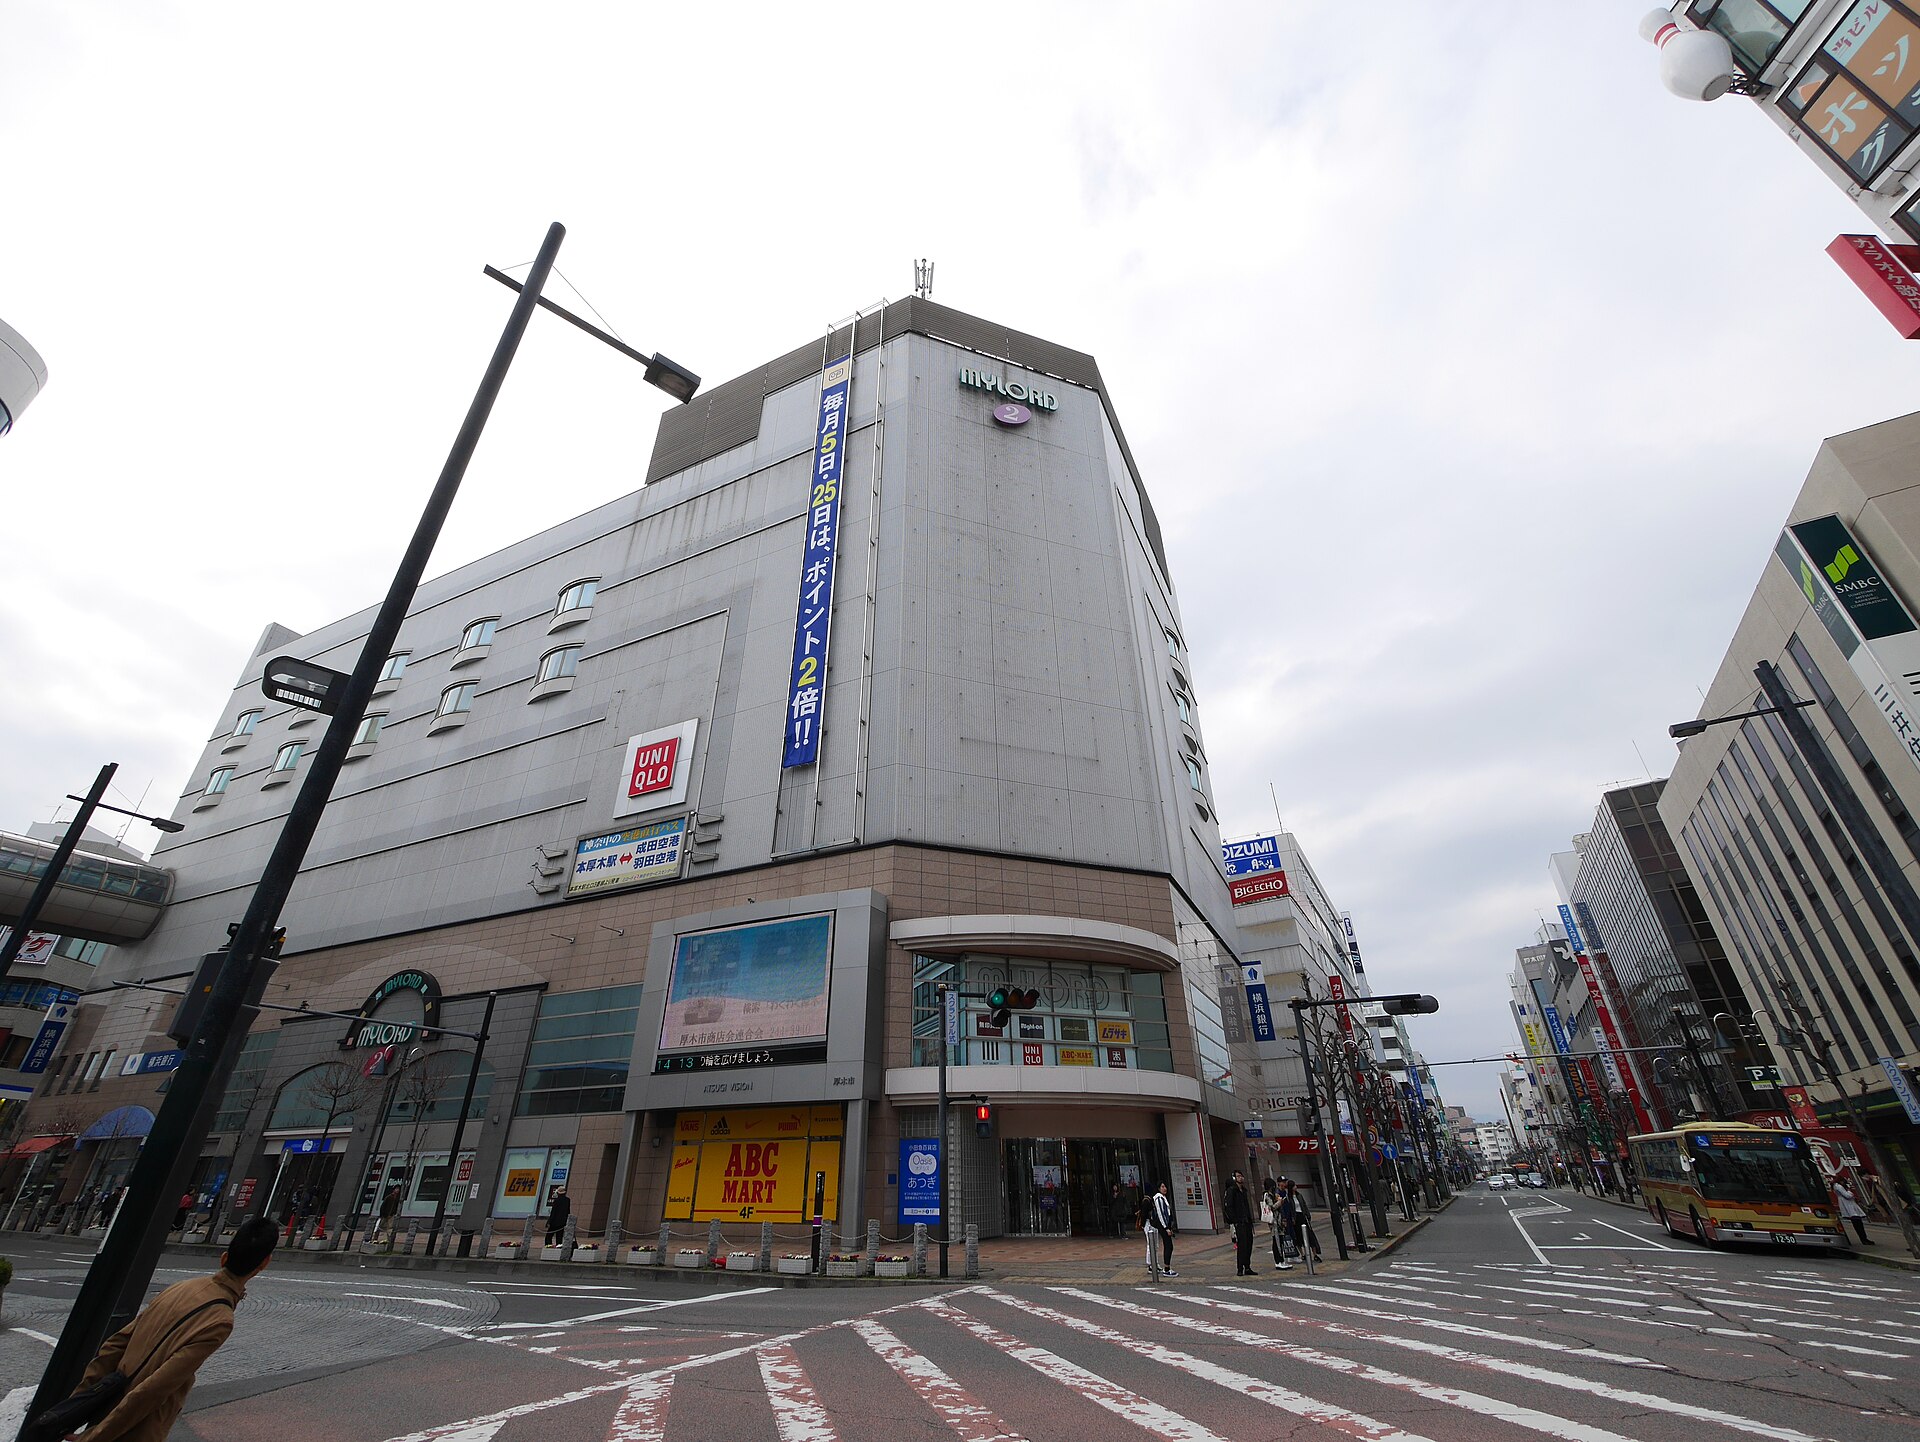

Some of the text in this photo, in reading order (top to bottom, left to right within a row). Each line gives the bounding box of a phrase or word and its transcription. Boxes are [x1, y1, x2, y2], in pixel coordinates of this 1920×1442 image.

[960, 367, 1060, 411] MYLORD
[1003, 405, 1020, 422] 2
[1834, 576, 1880, 594] SMBC
[638, 745, 670, 768] UNI
[634, 765, 669, 791] QLO
[635, 834, 680, 855] 成田空港
[575, 854, 618, 874] 本厚木駅
[632, 849, 678, 870] 羽田空港
[1234, 879, 1283, 899] BIG ECHO
[1351, 950, 1362, 968] TBC
[385, 973, 422, 994] MYLORD
[948, 993, 957, 1043] スクランブル式
[1252, 993, 1269, 1036] 横浜銀行
[679, 1027, 764, 1045] 厚木市商店会連合会
[1101, 1028, 1128, 1039] ムラサキ
[30, 1028, 57, 1068] 横浜銀行
[1024, 1046, 1040, 1054] UNI
[1061, 1050, 1093, 1059] ABC-MART
[148, 1054, 176, 1067] 横浜銀行
[1025, 1055, 1041, 1065] QLO
[832, 1076, 856, 1087] 厚木市
[1567, 1062, 1585, 1098] TSUTAYA
[1751, 1069, 1764, 1081] P
[703, 1081, 754, 1094] ATSUGI VISION
[680, 1120, 700, 1132] VANS
[710, 1128, 731, 1136] adidas
[777, 1121, 798, 1131] PUMA
[724, 1142, 780, 1178] ABC
[912, 1154, 933, 1166] Oasis
[508, 1178, 536, 1193] ムラサキ
[907, 1175, 937, 1189] あつぎ
[721, 1179, 777, 1204] MART
[739, 1206, 754, 1219] 4F
